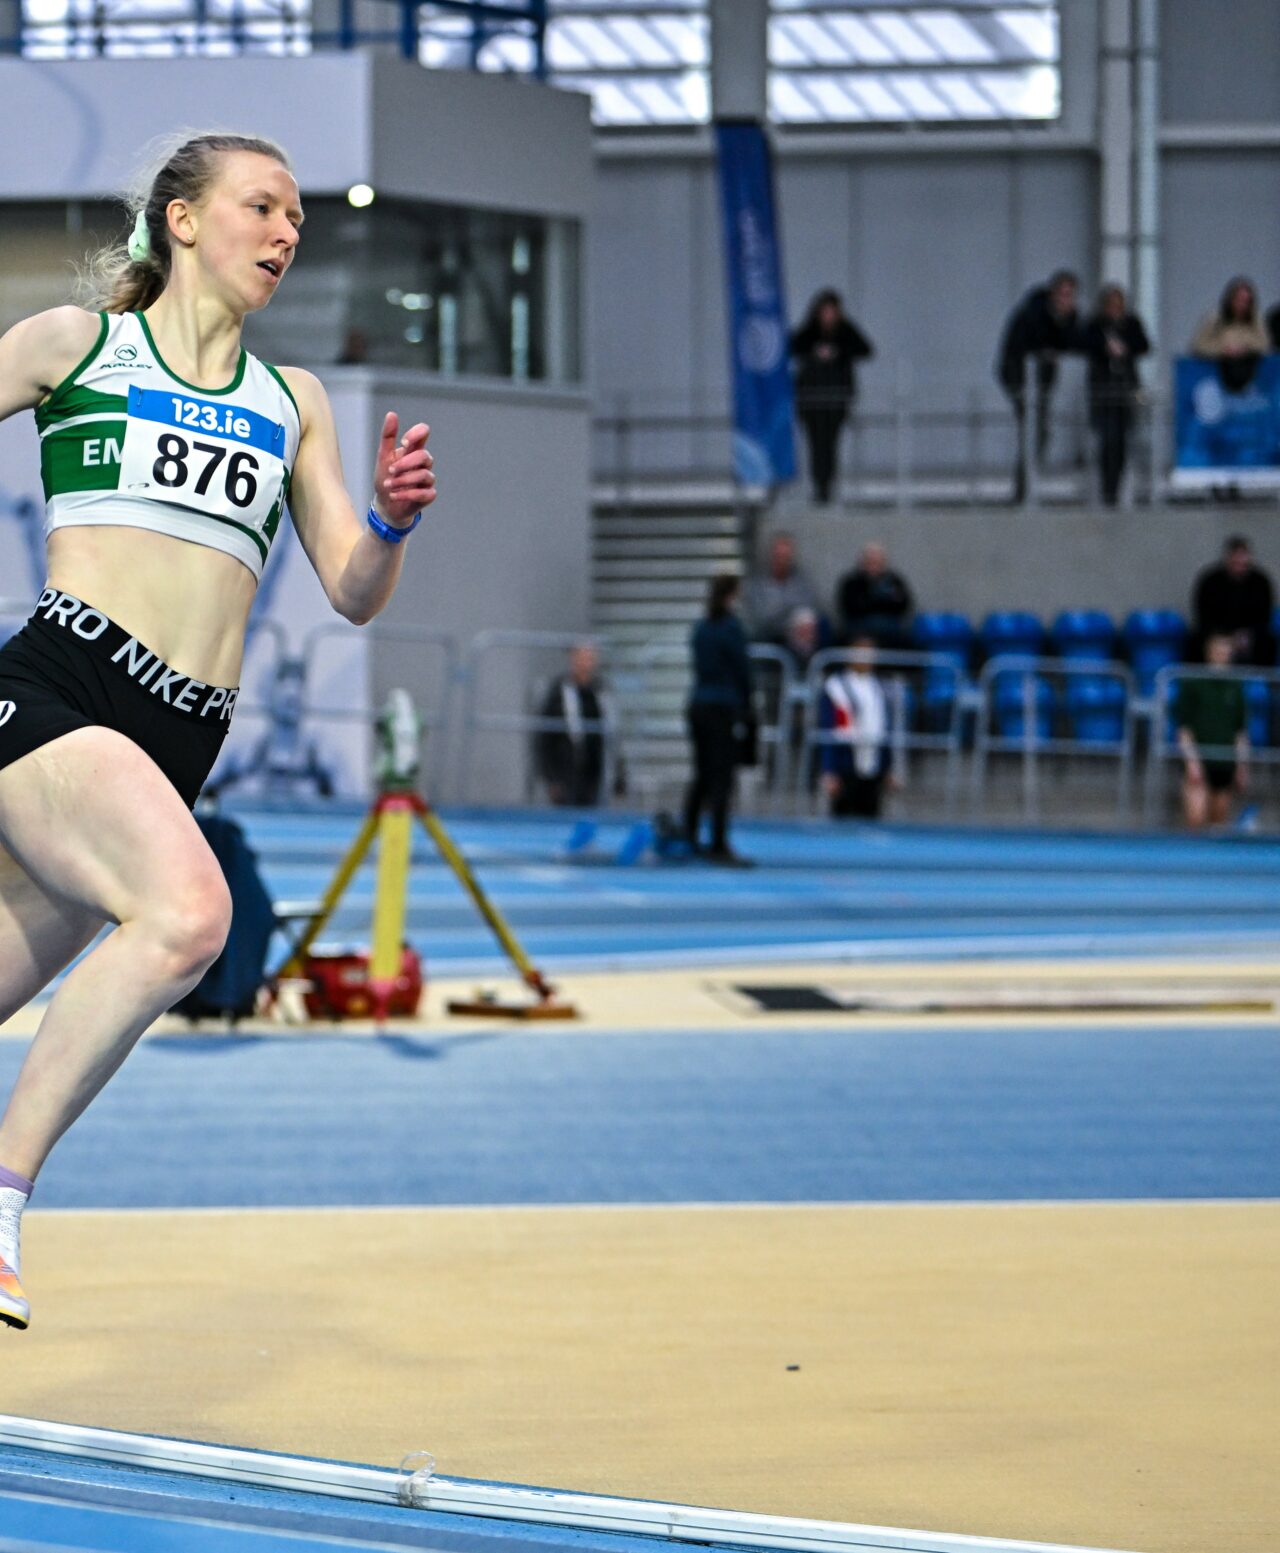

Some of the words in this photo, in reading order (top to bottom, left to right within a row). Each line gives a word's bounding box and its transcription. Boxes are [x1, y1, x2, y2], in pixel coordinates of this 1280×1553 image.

[171, 398, 251, 438] 123.ie
[152, 433, 260, 508] 876
[37, 588, 109, 641] PRO
[110, 637, 207, 712] NIKE
